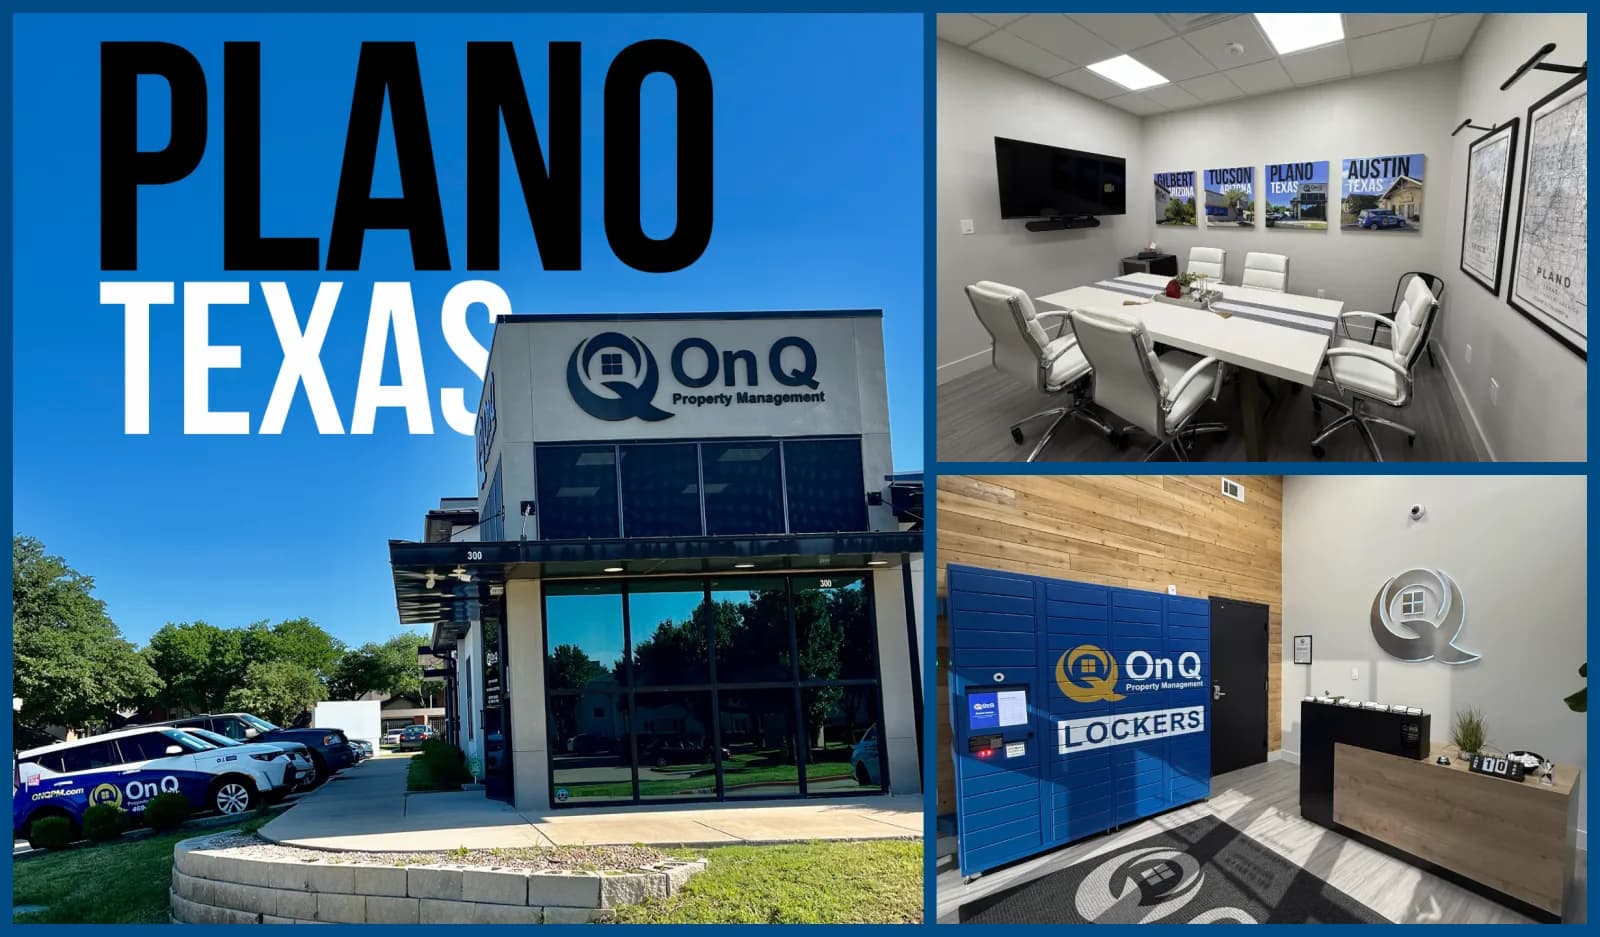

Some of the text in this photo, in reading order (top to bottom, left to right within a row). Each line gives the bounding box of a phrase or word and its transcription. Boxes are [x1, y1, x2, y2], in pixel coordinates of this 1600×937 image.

[1209, 168, 1251, 185] TUCSON
[1270, 162, 1314, 182] PLANO
[1347, 157, 1410, 179] AUSTIN
[1157, 172, 1194, 188] GILBERT
[1270, 181, 1299, 194] TEXAS
[1348, 179, 1384, 193] TEXAS
[1537, 266, 1571, 289] PLANO
[671, 336, 820, 391] On Q
[673, 390, 825, 407] Property Management
[467, 551, 482, 560] 300
[820, 579, 832, 588] 300
[1126, 650, 1202, 681] On Q
[1126, 681, 1204, 693] Property Management
[1064, 710, 1201, 748] LOCKERS
[31, 788, 84, 801] ONQPM.com
[126, 775, 180, 800] On Q
